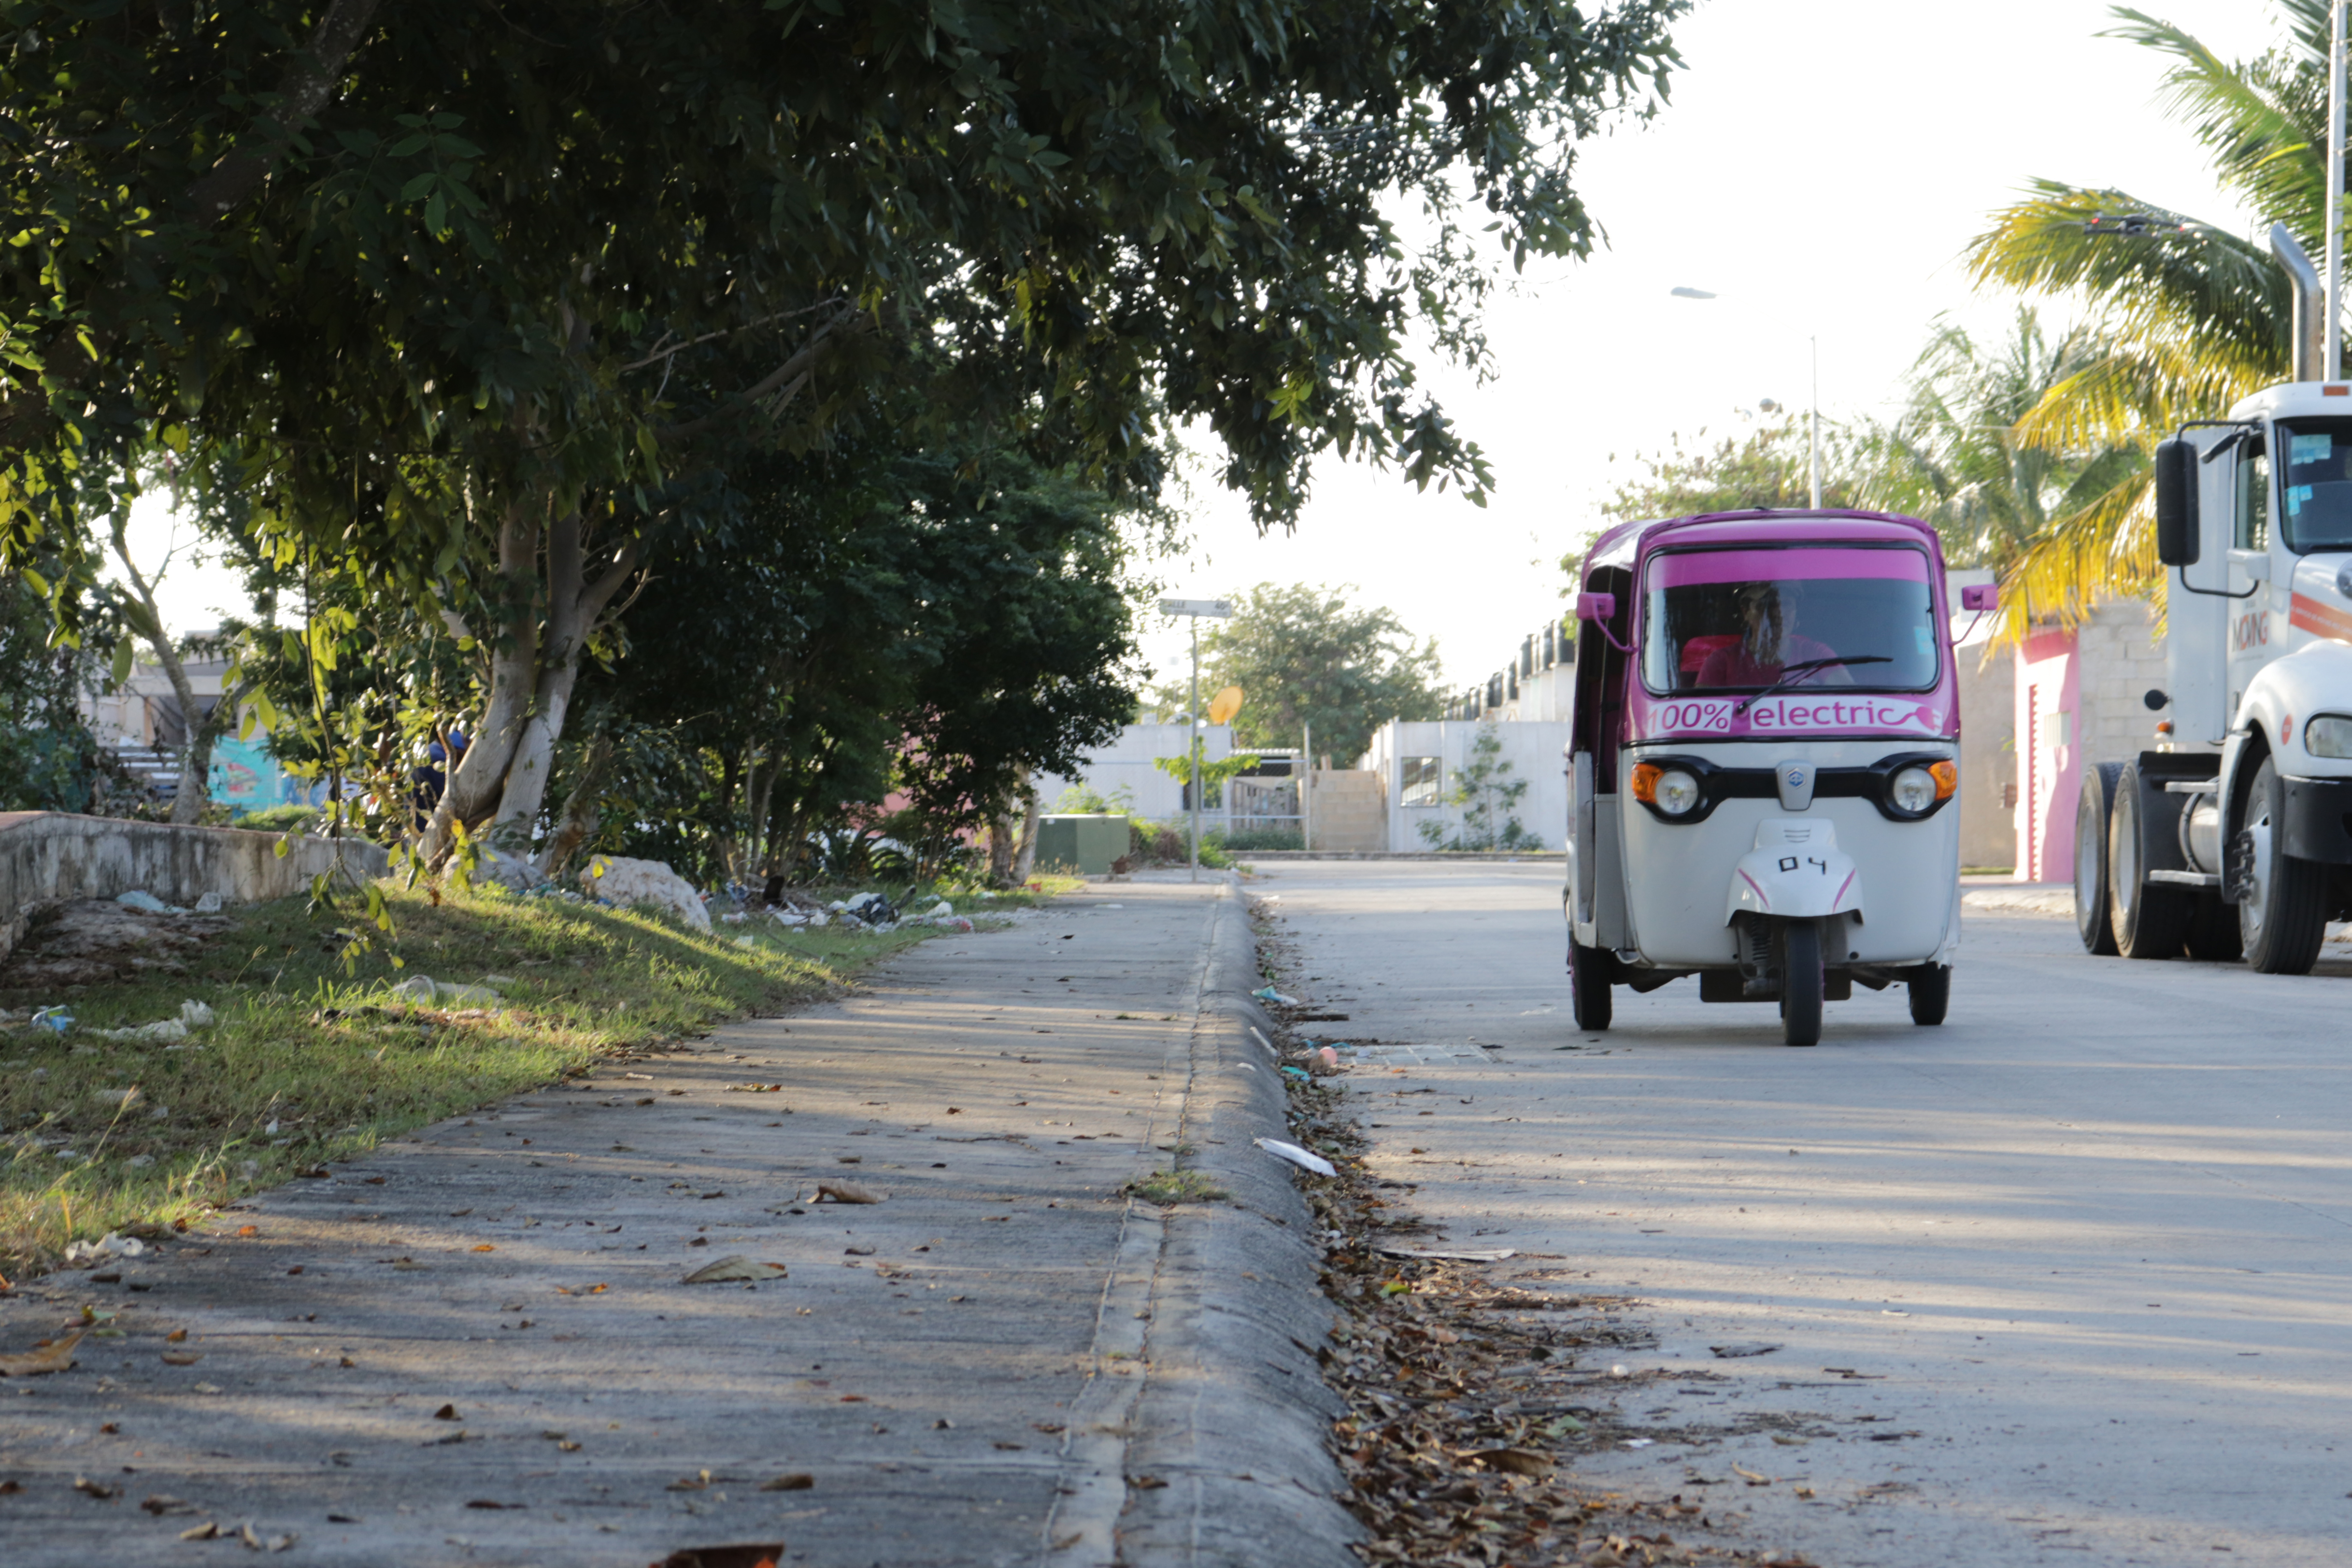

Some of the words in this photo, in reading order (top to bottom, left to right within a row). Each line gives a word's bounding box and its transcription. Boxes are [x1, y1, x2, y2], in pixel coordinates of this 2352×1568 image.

[1648, 703, 1728, 733] 100%
[1754, 700, 1896, 726] electric
[1779, 856, 1826, 875] 04
